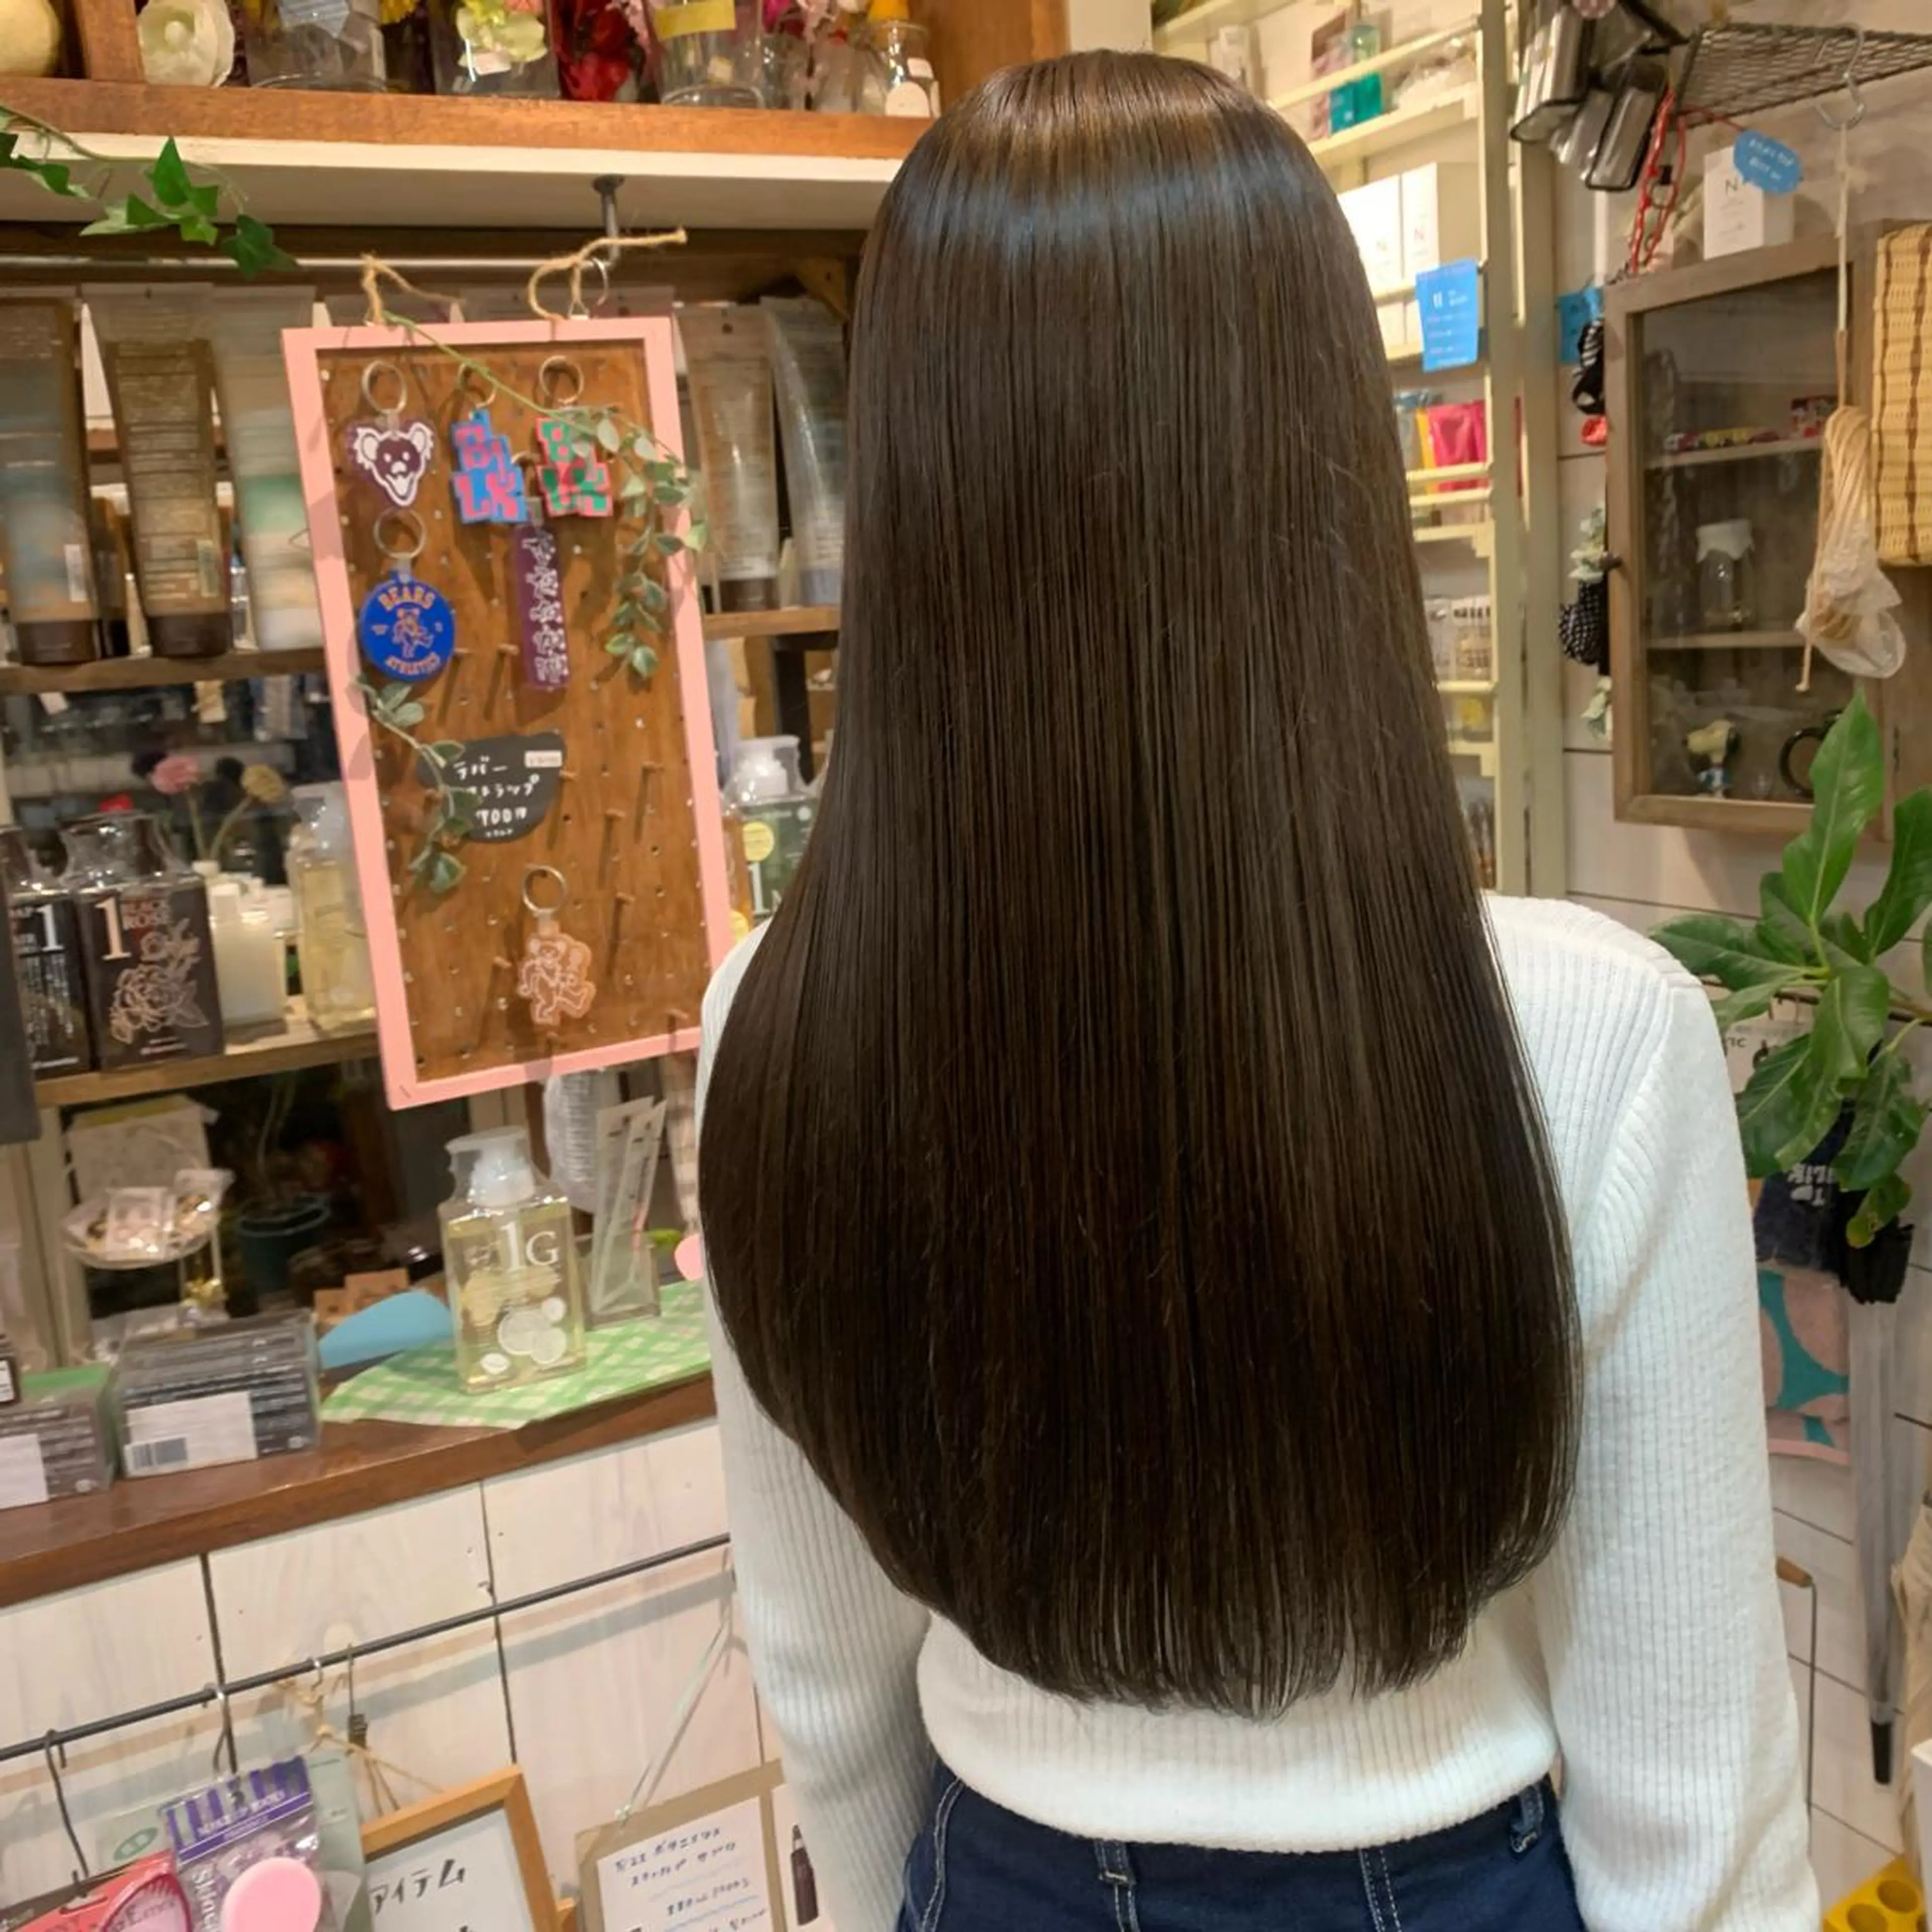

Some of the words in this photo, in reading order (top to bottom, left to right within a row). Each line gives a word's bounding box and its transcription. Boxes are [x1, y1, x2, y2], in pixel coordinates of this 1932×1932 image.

[379, 586, 436, 612] BEARS
[453, 756, 508, 780] ラバー
[37, 904, 64, 951] 1
[95, 897, 132, 960] 1
[368, 1859, 465, 1915] アイテム
